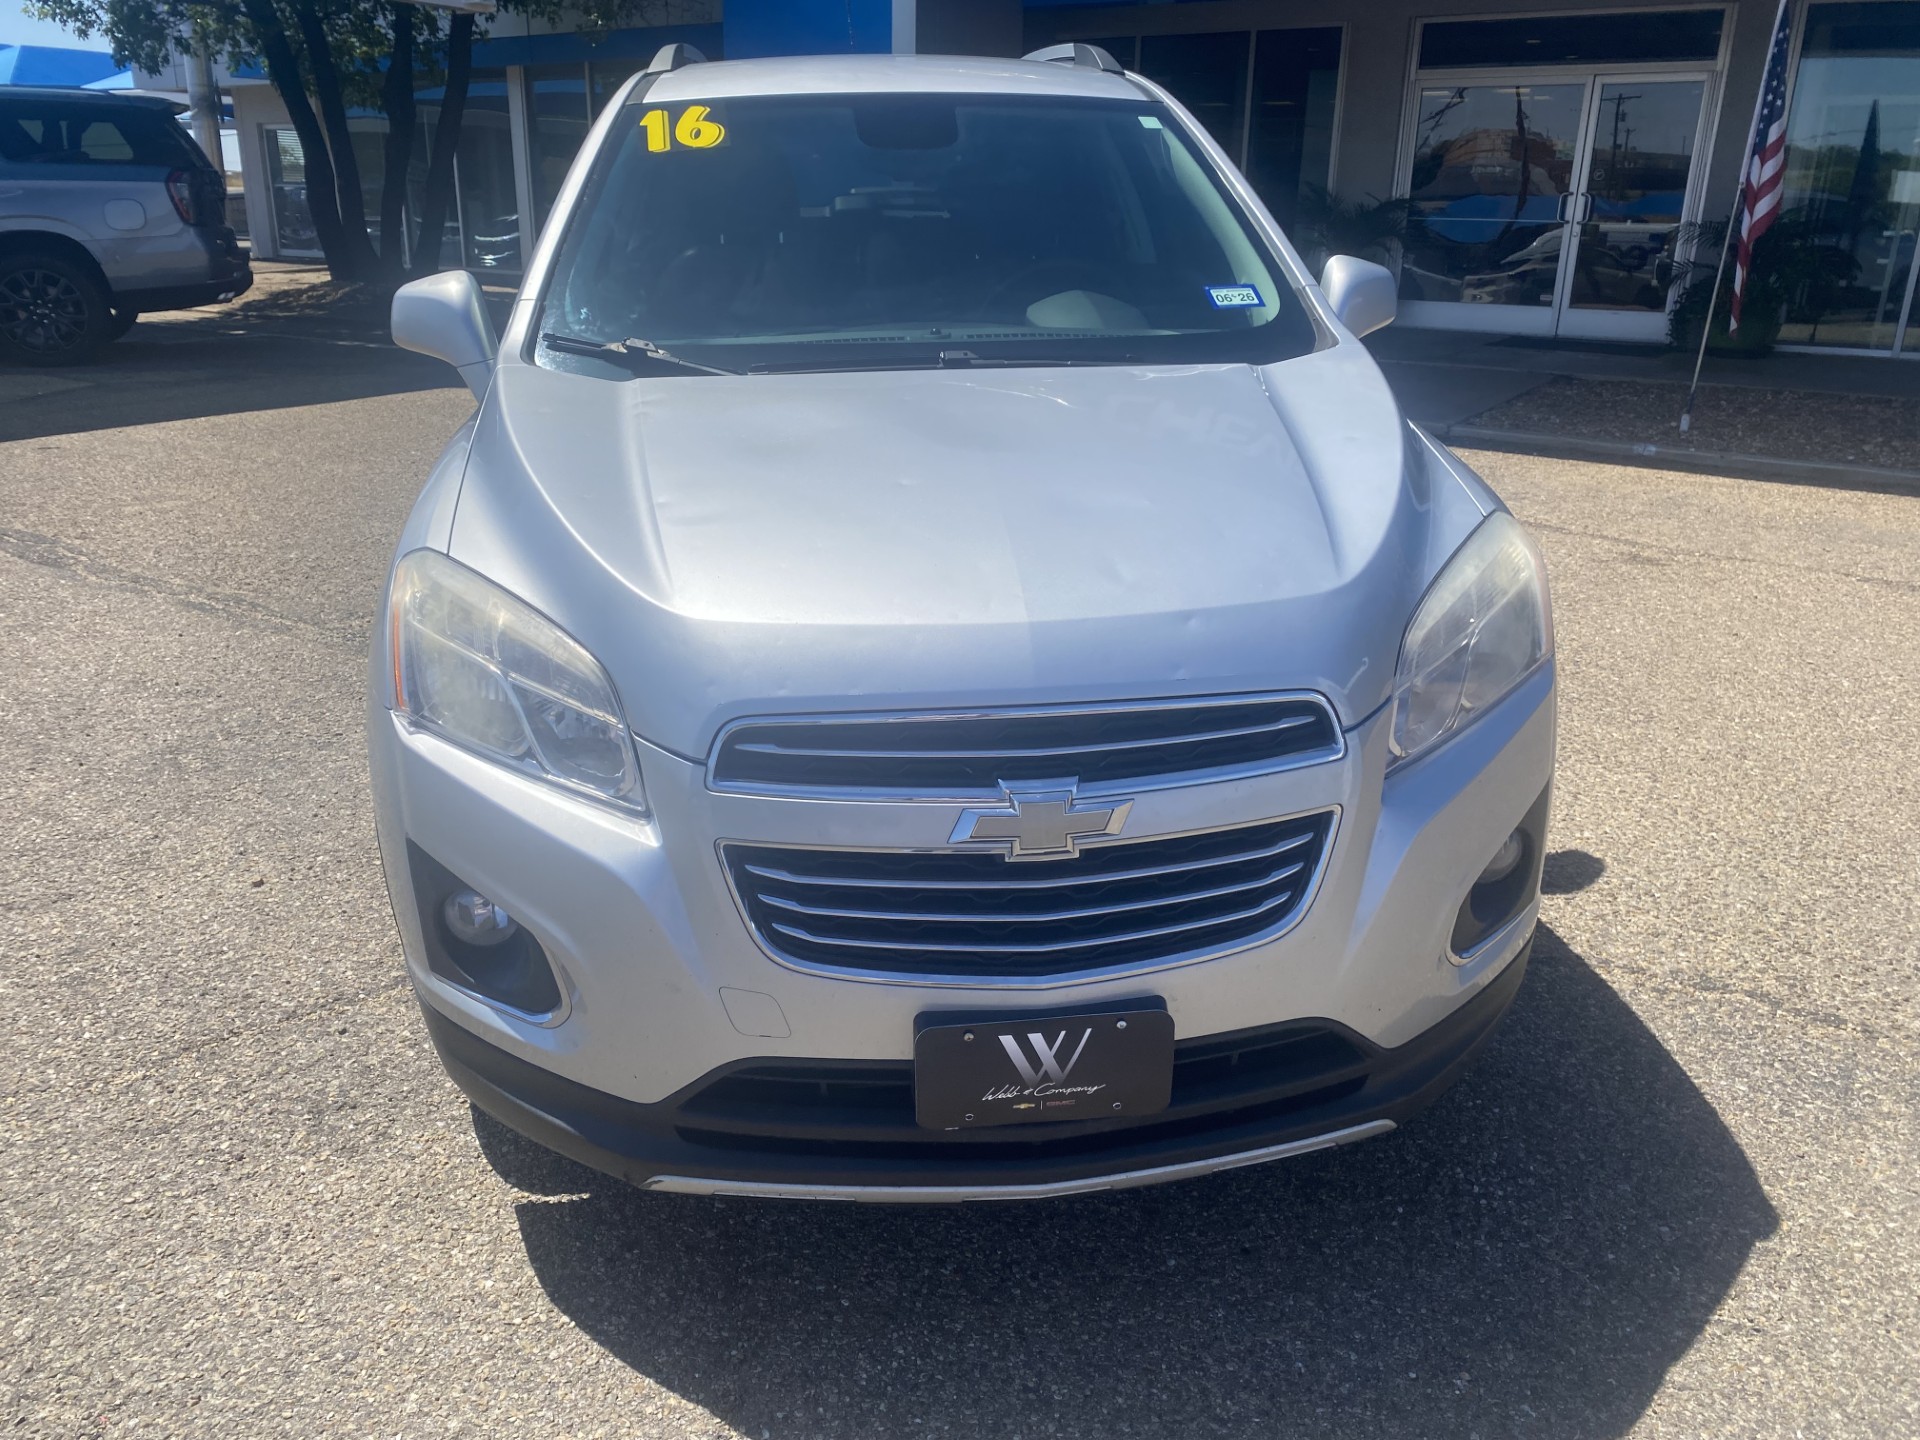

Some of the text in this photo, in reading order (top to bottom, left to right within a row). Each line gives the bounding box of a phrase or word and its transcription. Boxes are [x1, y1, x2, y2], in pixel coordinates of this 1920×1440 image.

[639, 105, 725, 153] 16
[1215, 292, 1255, 303] 06 26
[981, 1084, 1020, 1101] Webb
[1034, 1082, 1107, 1097] Company
